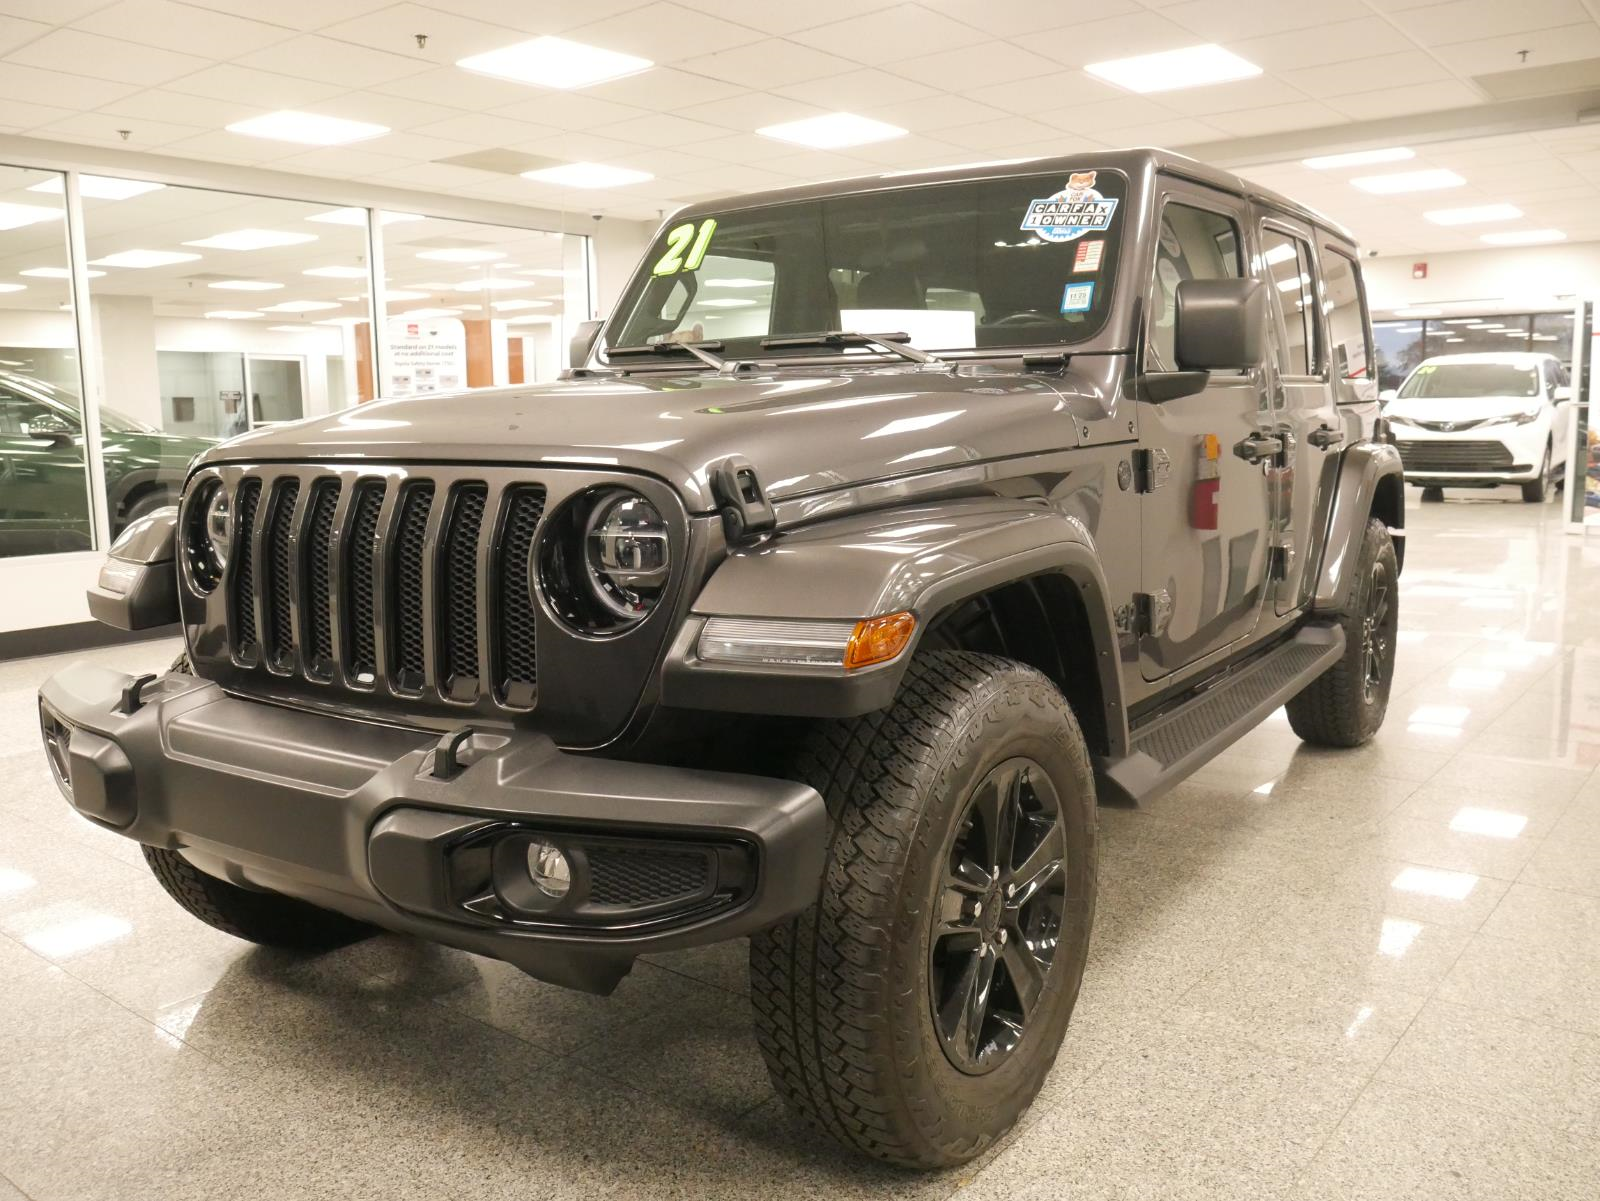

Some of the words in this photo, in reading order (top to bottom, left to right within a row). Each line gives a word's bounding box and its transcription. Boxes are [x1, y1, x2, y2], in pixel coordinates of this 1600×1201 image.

[1033, 203, 1108, 214] CARFAX
[1041, 215, 1105, 225] OWNER
[651, 219, 718, 275] 21
